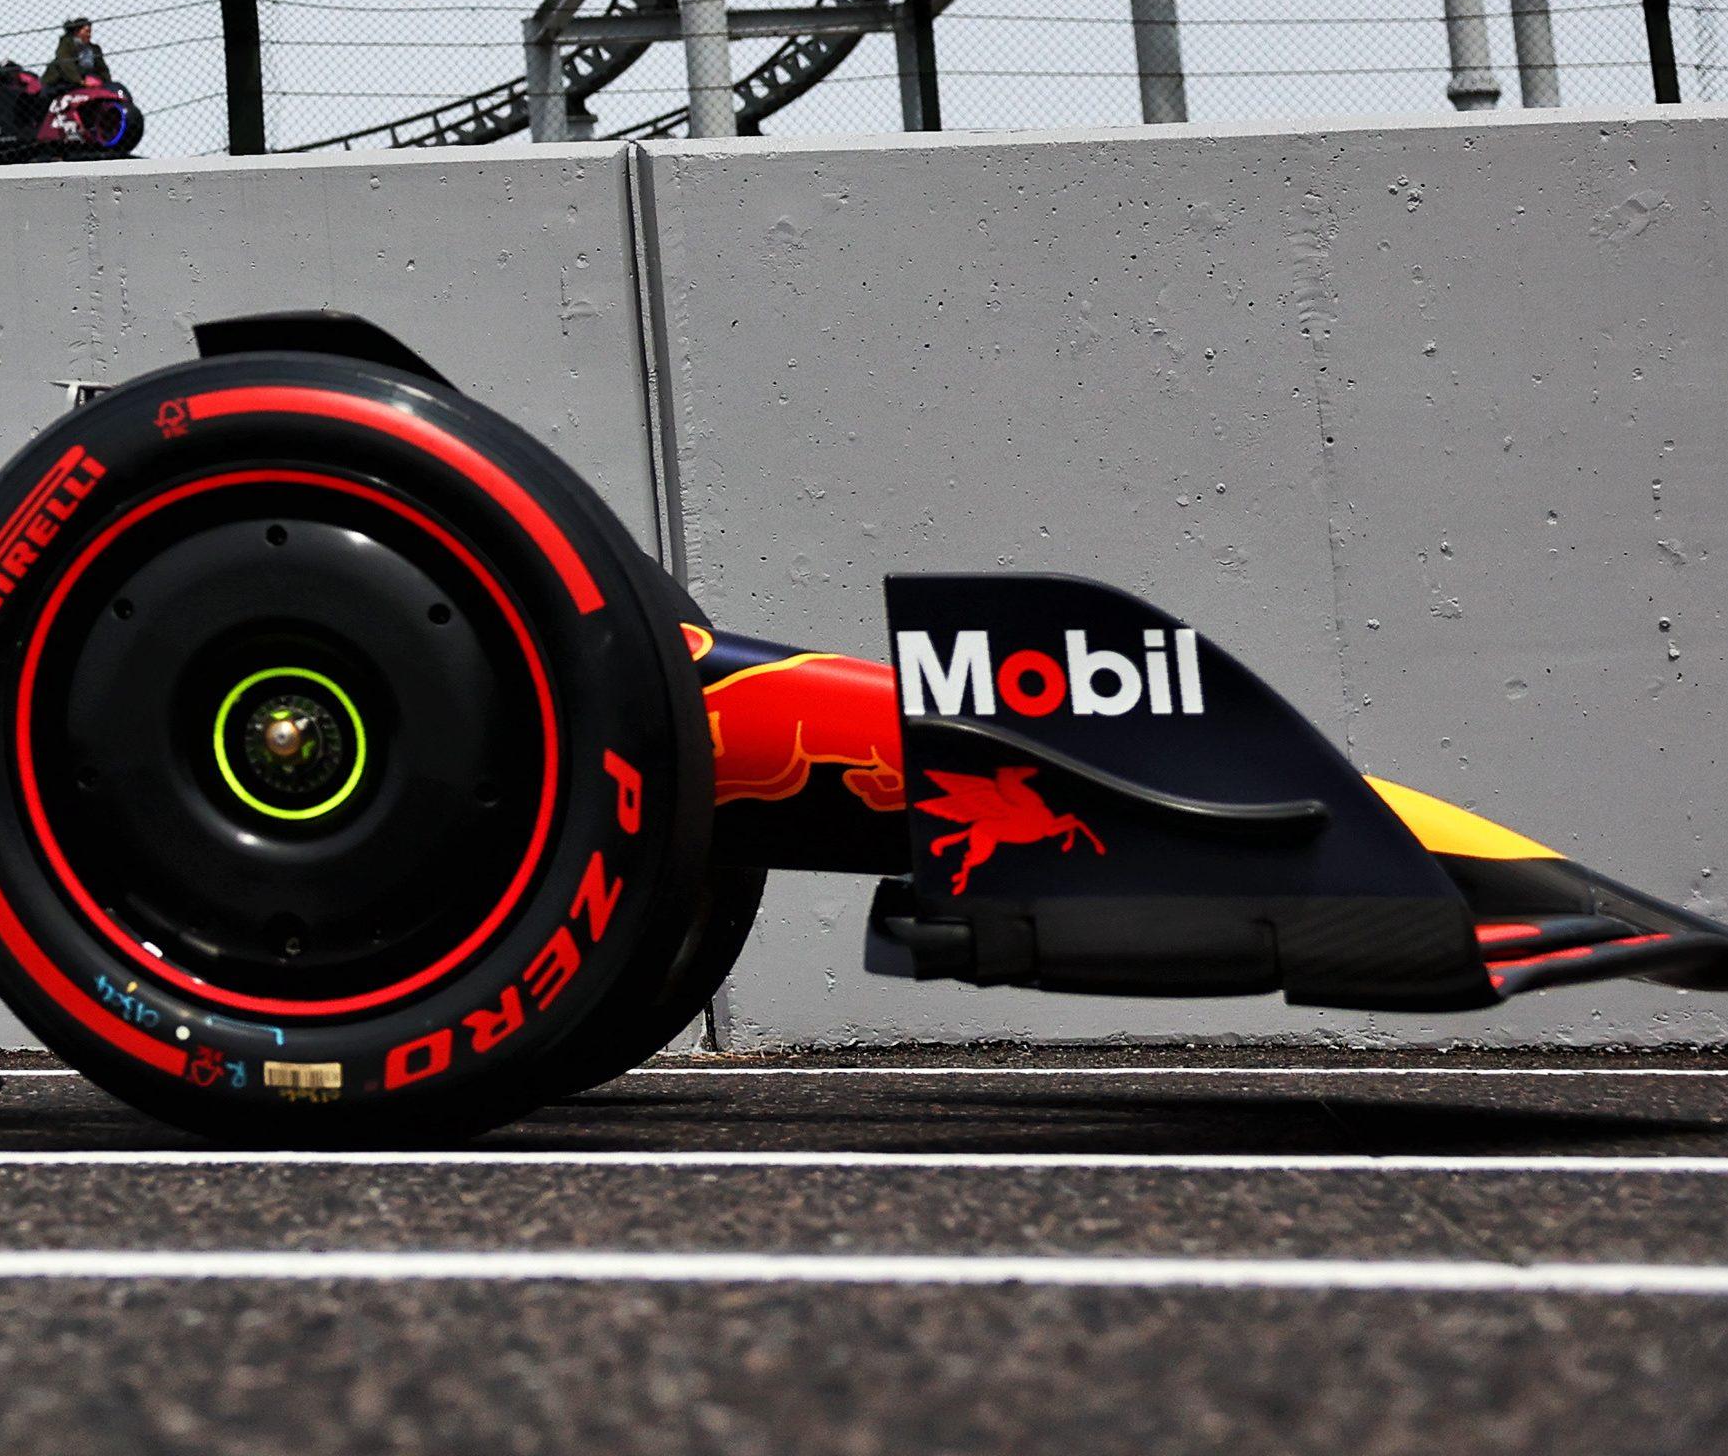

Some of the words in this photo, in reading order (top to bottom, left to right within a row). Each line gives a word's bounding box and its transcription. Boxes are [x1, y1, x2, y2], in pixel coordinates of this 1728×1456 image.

[897, 629, 1205, 718] Mobil
[603, 749, 643, 835] P
[384, 852, 624, 1091] ZERO
